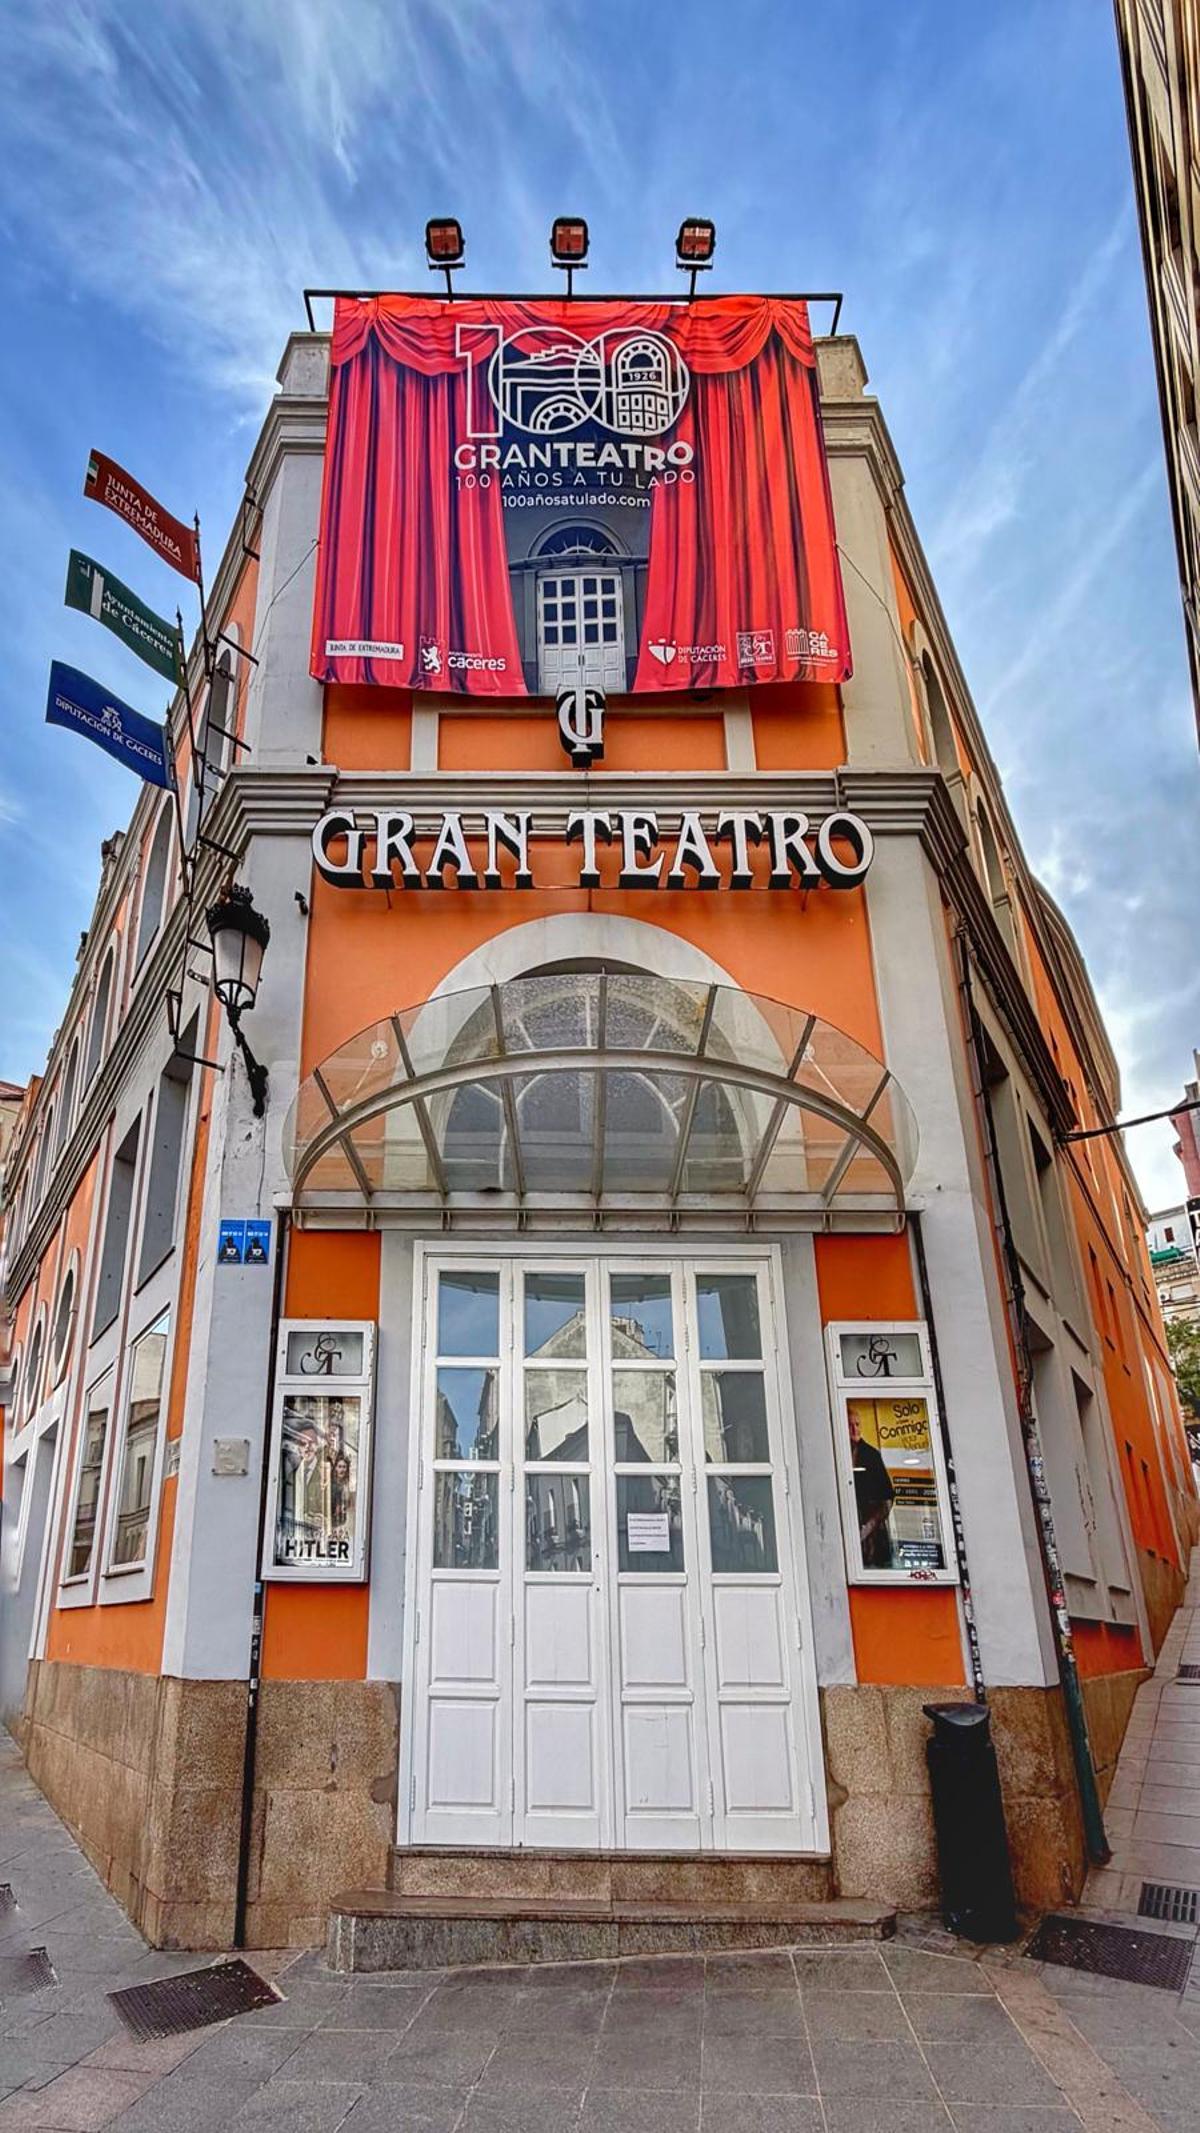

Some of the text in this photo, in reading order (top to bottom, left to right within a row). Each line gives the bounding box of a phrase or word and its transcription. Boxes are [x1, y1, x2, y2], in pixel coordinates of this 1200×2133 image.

[628, 372, 657, 382] 1926
[454, 441, 694, 473] GRANTEATRO
[455, 469, 696, 490] 100 AÑOS A TU LADO
[106, 473, 159, 524] JUNTA DE
[502, 492, 651, 509] 100añosatulado.com
[104, 486, 182, 559] EXTREMADURA
[102, 600, 119, 619] de
[103, 590, 174, 648] Ayuntamiento
[112, 732, 125, 745] DE
[311, 811, 876, 889] GRAN TEATRO
[893, 1402, 920, 1418] Solo
[284, 1539, 350, 1559] HITLER
